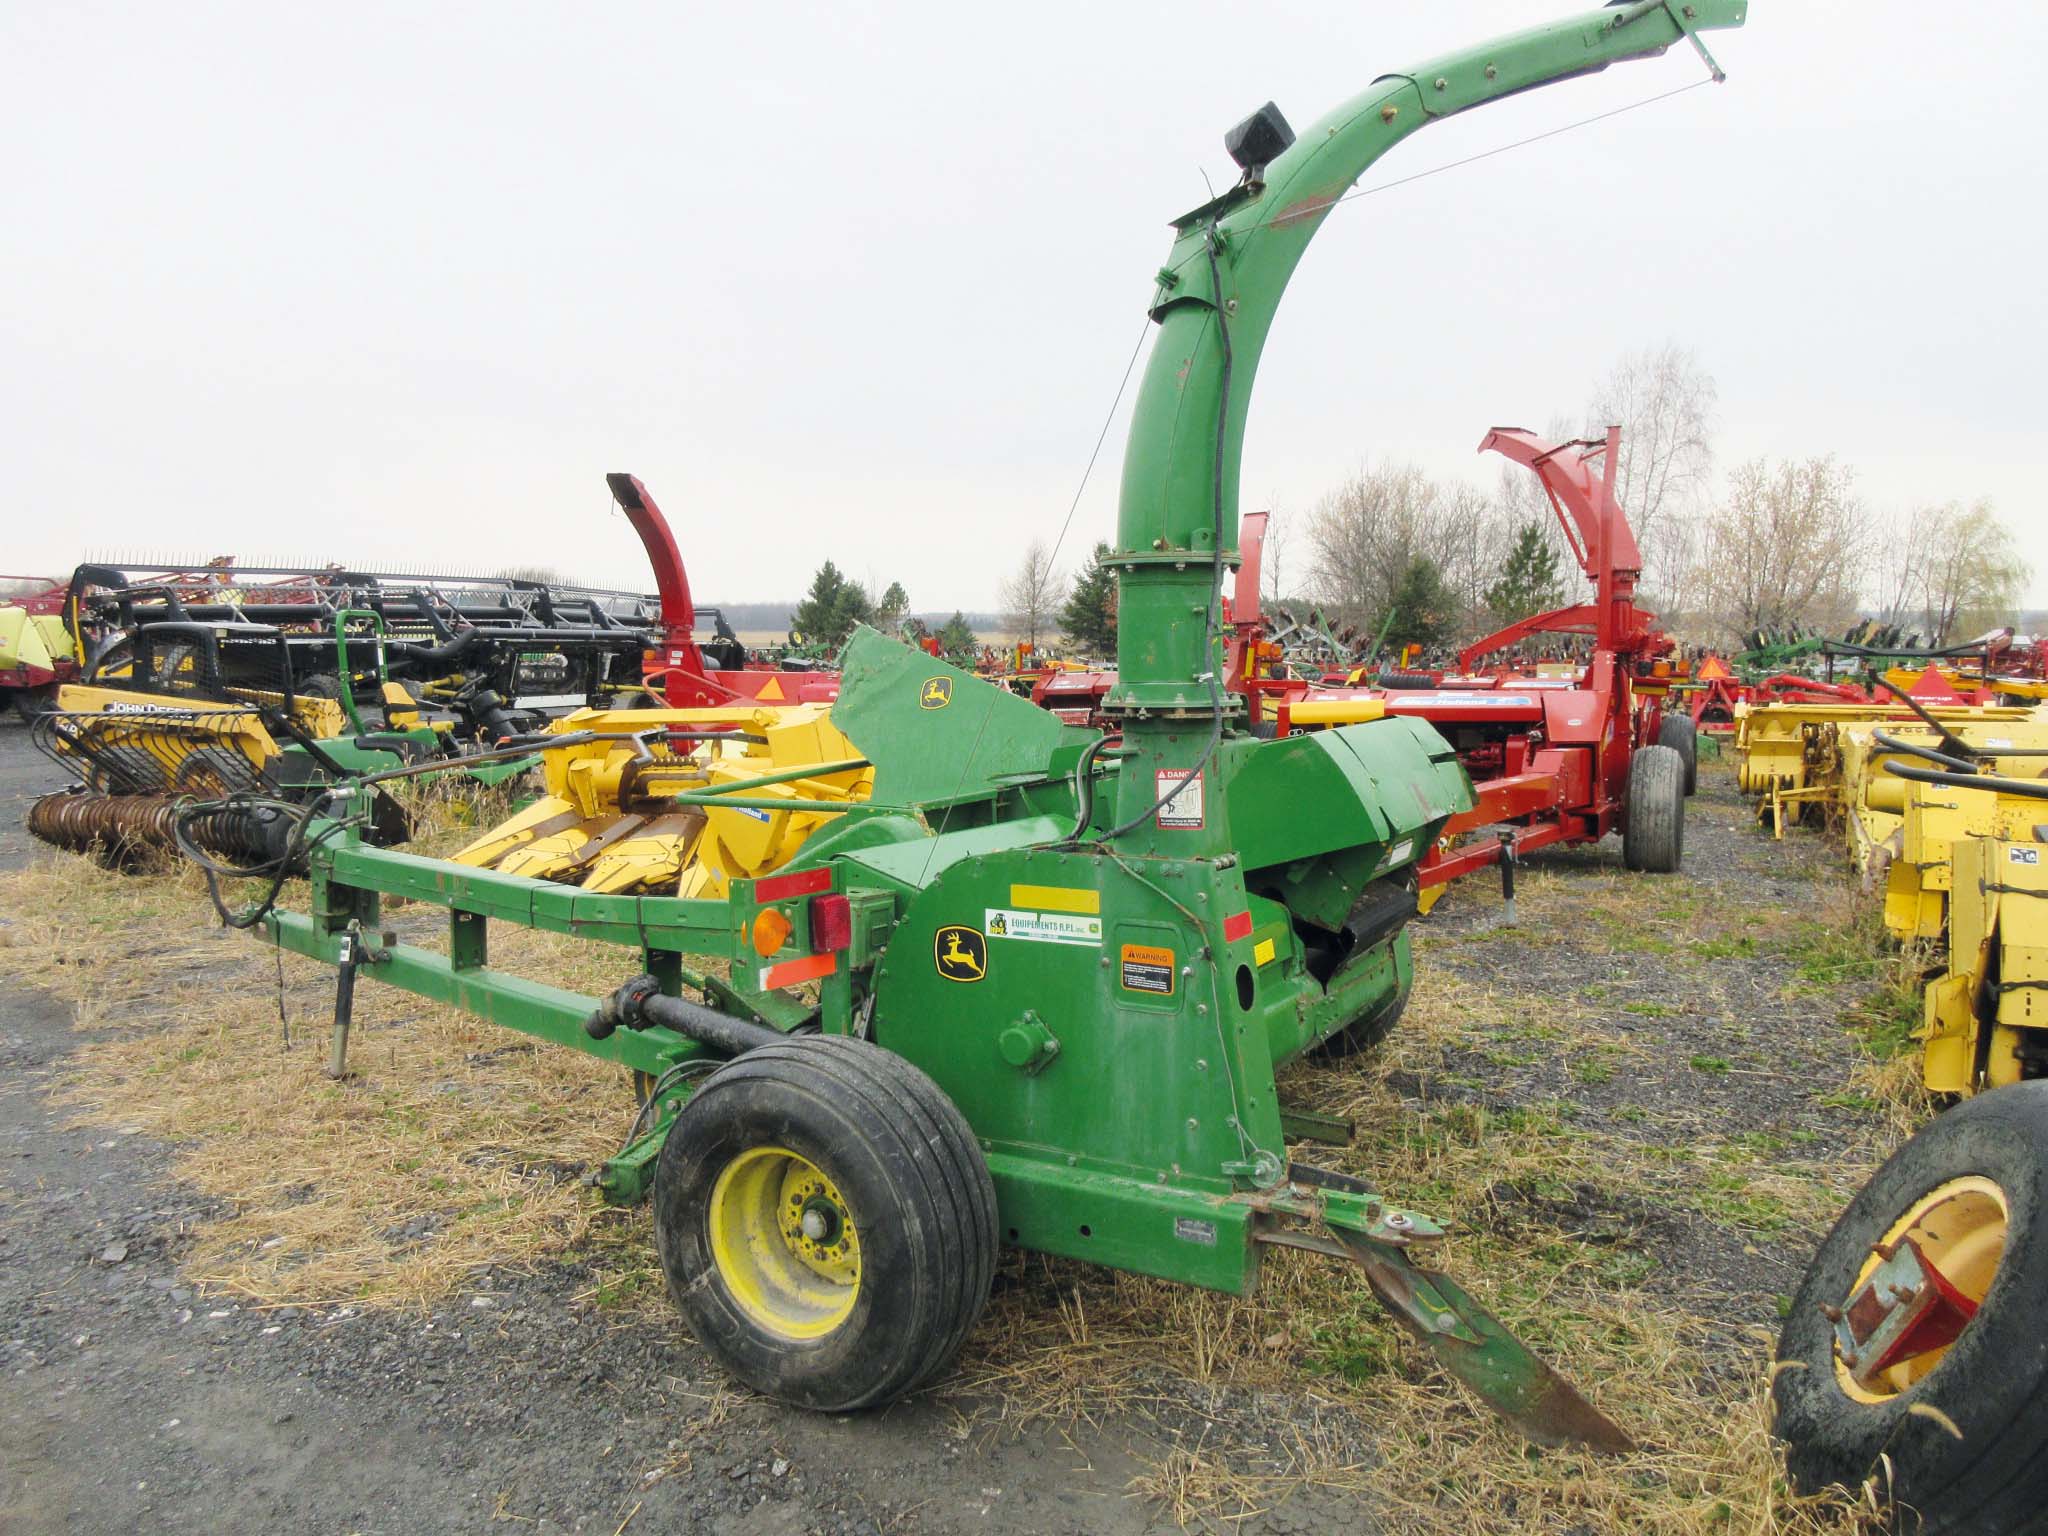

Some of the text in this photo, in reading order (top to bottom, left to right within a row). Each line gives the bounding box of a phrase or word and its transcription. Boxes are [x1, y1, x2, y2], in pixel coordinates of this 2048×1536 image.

[110, 701, 145, 713] JOHN
[1167, 771, 1201, 779] DANGR
[1136, 952, 1168, 962] WARNING
